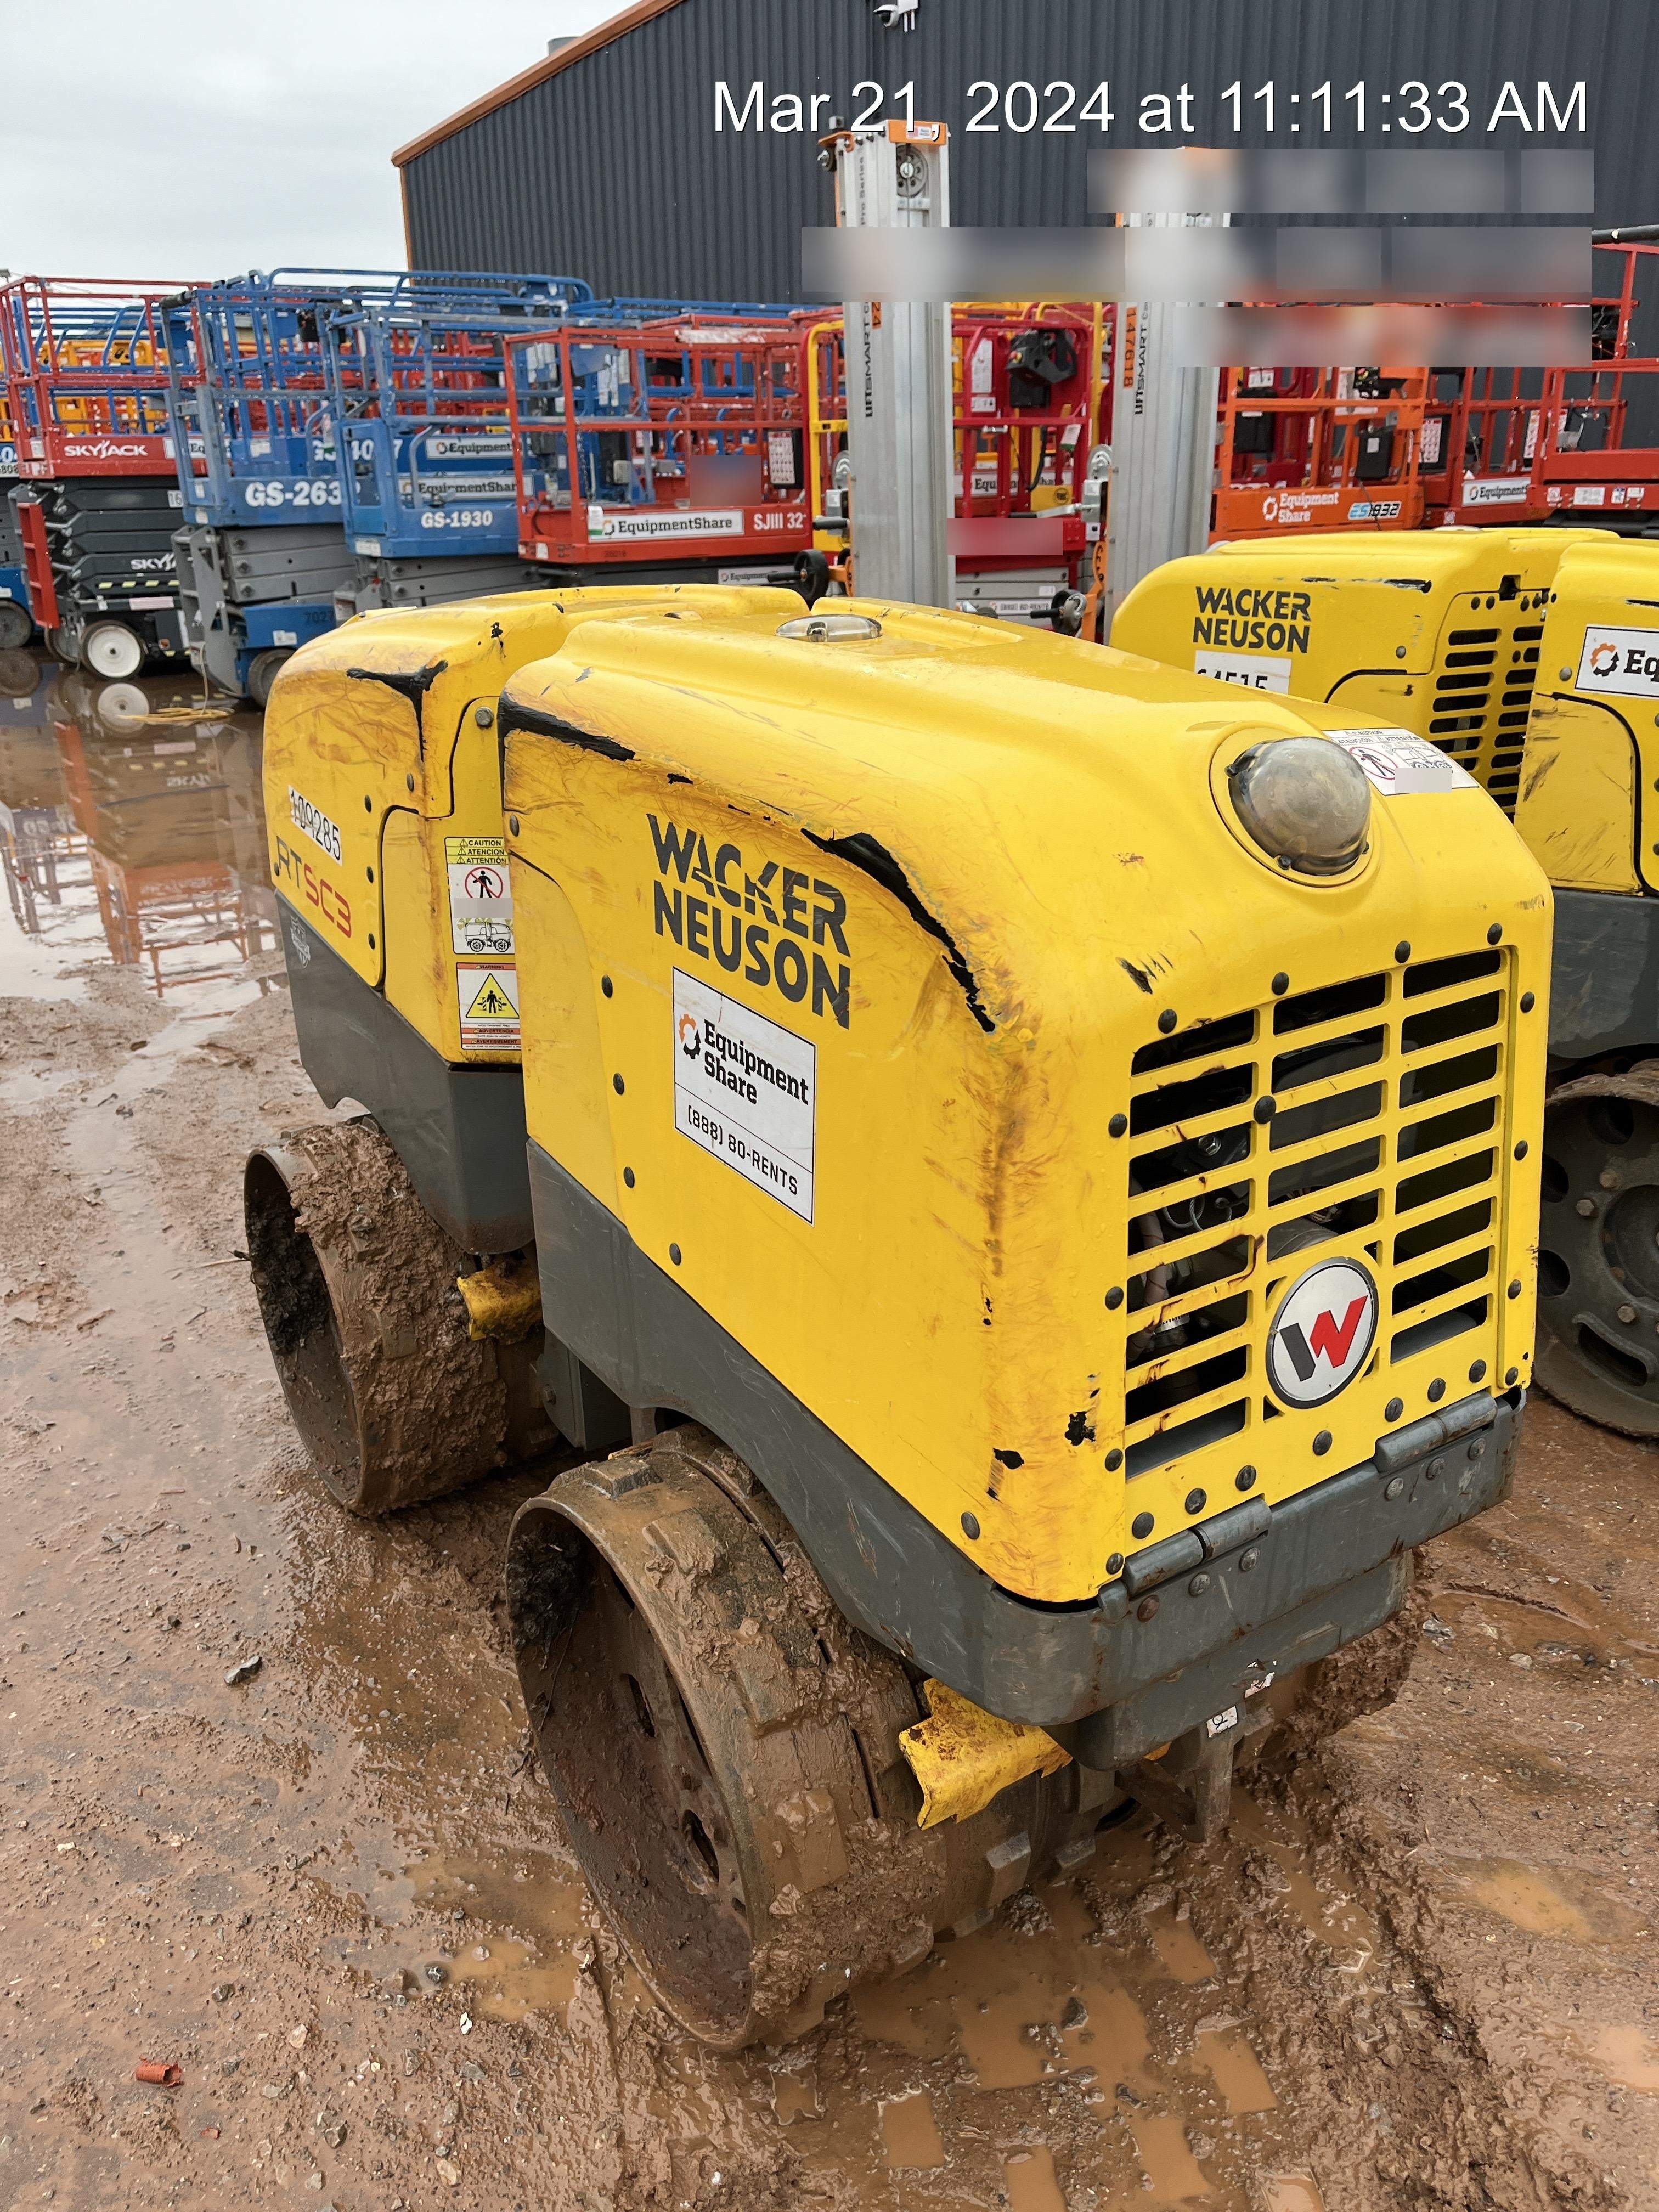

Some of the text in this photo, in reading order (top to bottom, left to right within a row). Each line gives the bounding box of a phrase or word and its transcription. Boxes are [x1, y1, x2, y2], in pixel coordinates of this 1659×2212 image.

[64, 439, 149, 459] SKYJACK
[421, 510, 493, 529] GS-1930
[1279, 509, 1311, 523] Share
[1280, 492, 1339, 509] Equipment
[618, 516, 732, 535] EquipmentShare
[1195, 586, 1312, 622] WACKER
[1192, 616, 1310, 654] NEUSON
[291, 789, 341, 861] 109285
[646, 813, 851, 958] WACKER
[653, 879, 851, 1030] NEUSON
[704, 1019, 809, 1106] Equipment
[704, 1052, 758, 1105] Share
[687, 1104, 798, 1195] (888) 80-RENTS
